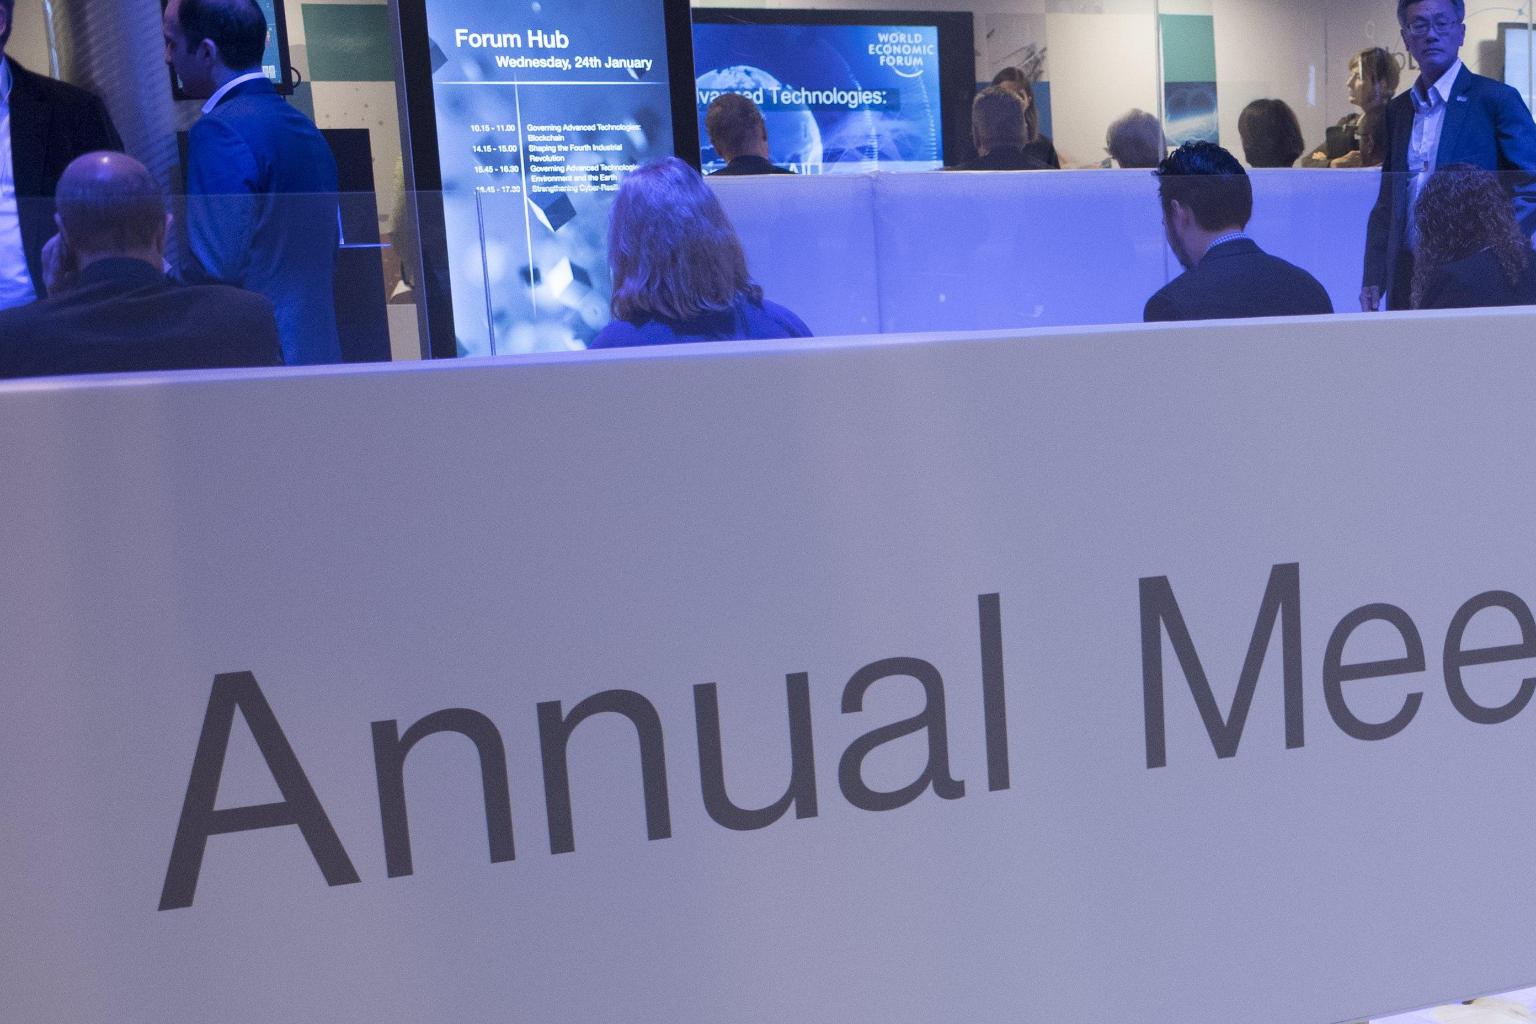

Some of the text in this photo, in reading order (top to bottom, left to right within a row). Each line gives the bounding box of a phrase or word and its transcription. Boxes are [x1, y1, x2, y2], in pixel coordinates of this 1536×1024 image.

[455, 29, 570, 49] Forum Hub
[878, 33, 922, 43] WORLD
[868, 44, 934, 55] ECONOMIC
[495, 55, 653, 72] Wednesday, 24th January
[879, 56, 923, 66] FORUM
[769, 88, 887, 109] Technologies:
[527, 124, 562, 133] Governing
[528, 134, 565, 142] Blockchain
[528, 144, 557, 154] Shaping
[593, 143, 623, 151] Industrial
[530, 165, 565, 174] Governing
[566, 164, 599, 172] Advanced
[531, 174, 573, 183] Environment
[574, 174, 588, 182] and
[532, 185, 578, 194] Strengthening
[156, 591, 1011, 911] Annual
